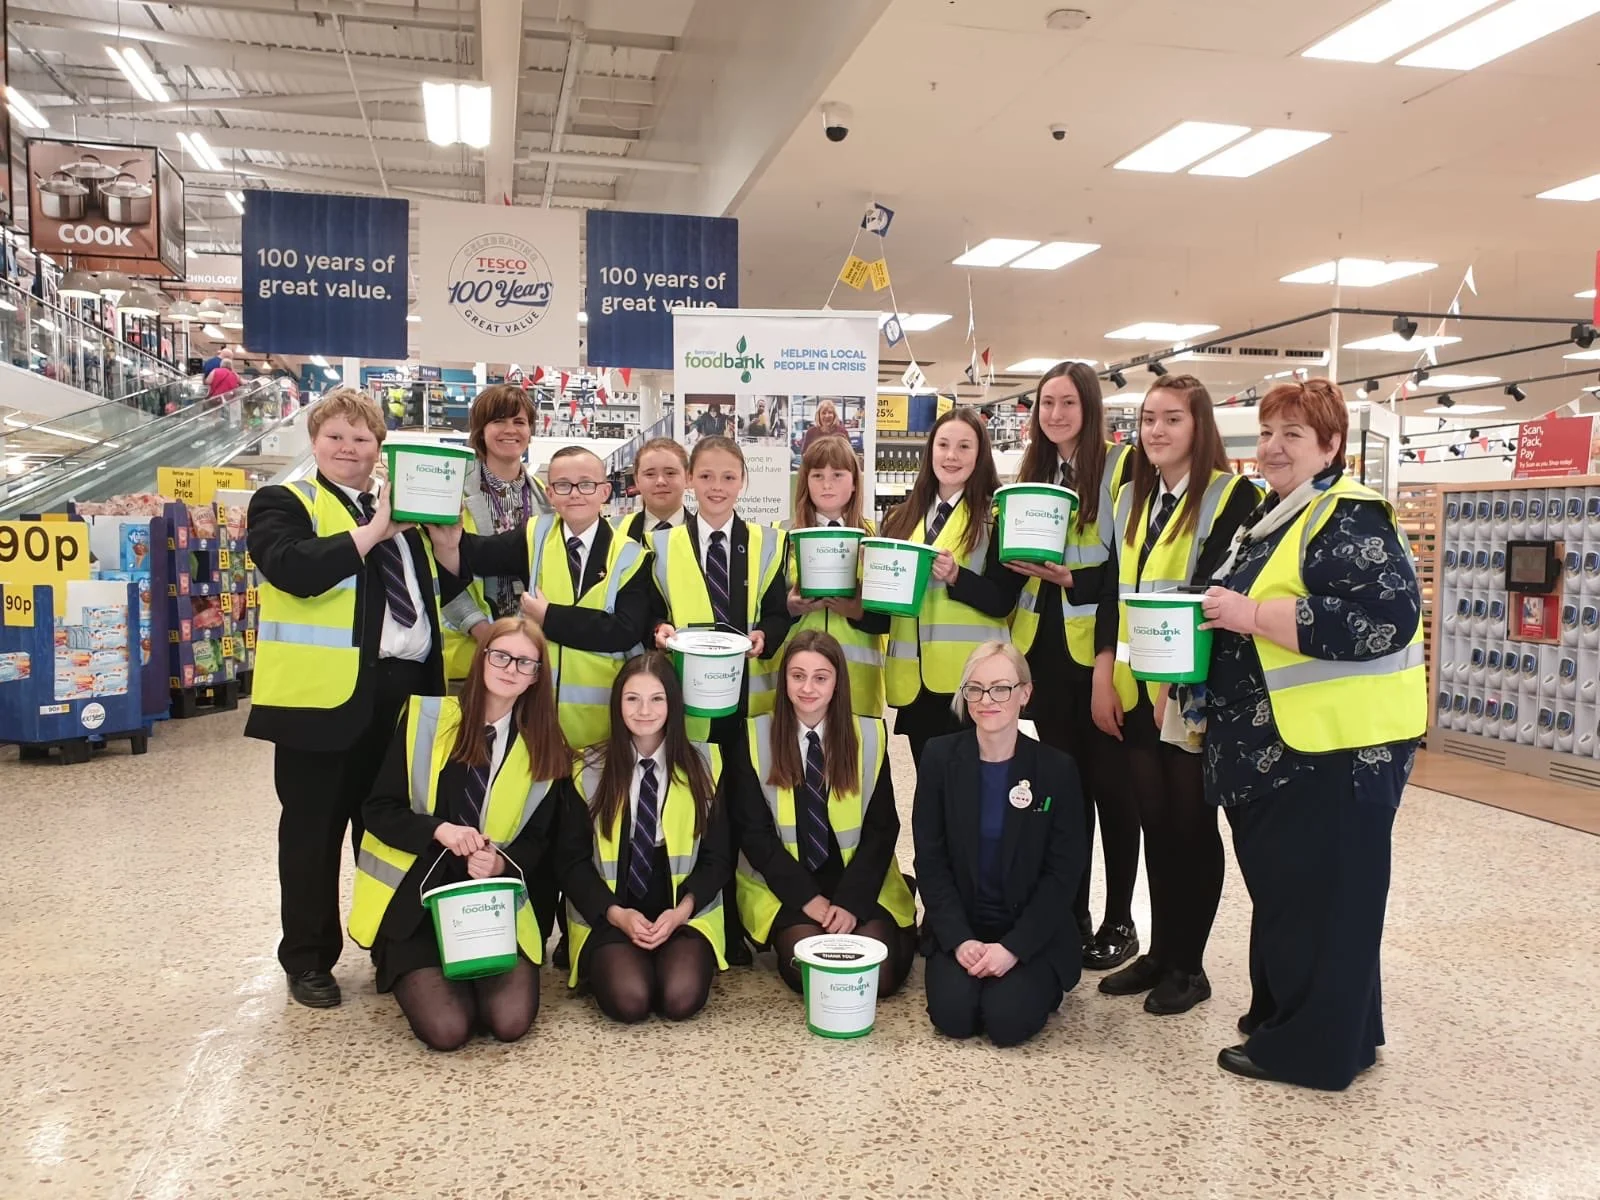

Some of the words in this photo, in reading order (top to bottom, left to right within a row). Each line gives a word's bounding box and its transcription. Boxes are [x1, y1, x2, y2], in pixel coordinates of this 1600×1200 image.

[58, 224, 133, 247] COOK
[463, 236, 538, 263] CELEBRATING
[257, 248, 298, 268] 100
[305, 254, 366, 274] years
[372, 255, 396, 273] of
[476, 257, 527, 270] TESCO
[174, 275, 238, 285] CHNOLOGY
[600, 267, 637, 286] 100
[643, 272, 699, 291] years
[705, 272, 727, 290] of
[259, 278, 319, 299] great
[325, 279, 392, 300] value.
[448, 280, 493, 304] 100
[495, 279, 553, 308] Years
[601, 295, 656, 315] great
[464, 309, 500, 333] GREAT
[505, 311, 540, 333] VALUE
[781, 348, 829, 359] HELPING
[831, 349, 867, 360] LOCAL
[685, 352, 766, 369] foodbank
[774, 361, 817, 371] PEOPLE
[818, 362, 830, 371] IN
[831, 362, 866, 372] CRISIS
[1522, 424, 1544, 436] Scan,
[1521, 435, 1542, 448] Pack,
[746, 456, 764, 464] yone
[1520, 448, 1535, 461] Pay
[748, 465, 764, 473] ould
[176, 479, 191, 488] Half
[216, 479, 231, 488] Half
[174, 489, 193, 498] Price
[747, 505, 779, 514] balanced
[1025, 510, 1064, 521] foodbank
[0, 525, 79, 571] 90p
[6, 595, 32, 615] 90p
[222, 595, 230, 607] £1
[1133, 626, 1182, 635] foodbank
[224, 641, 232, 652] £1
[462, 902, 506, 916] foodbank
[829, 982, 870, 992] foodbank
